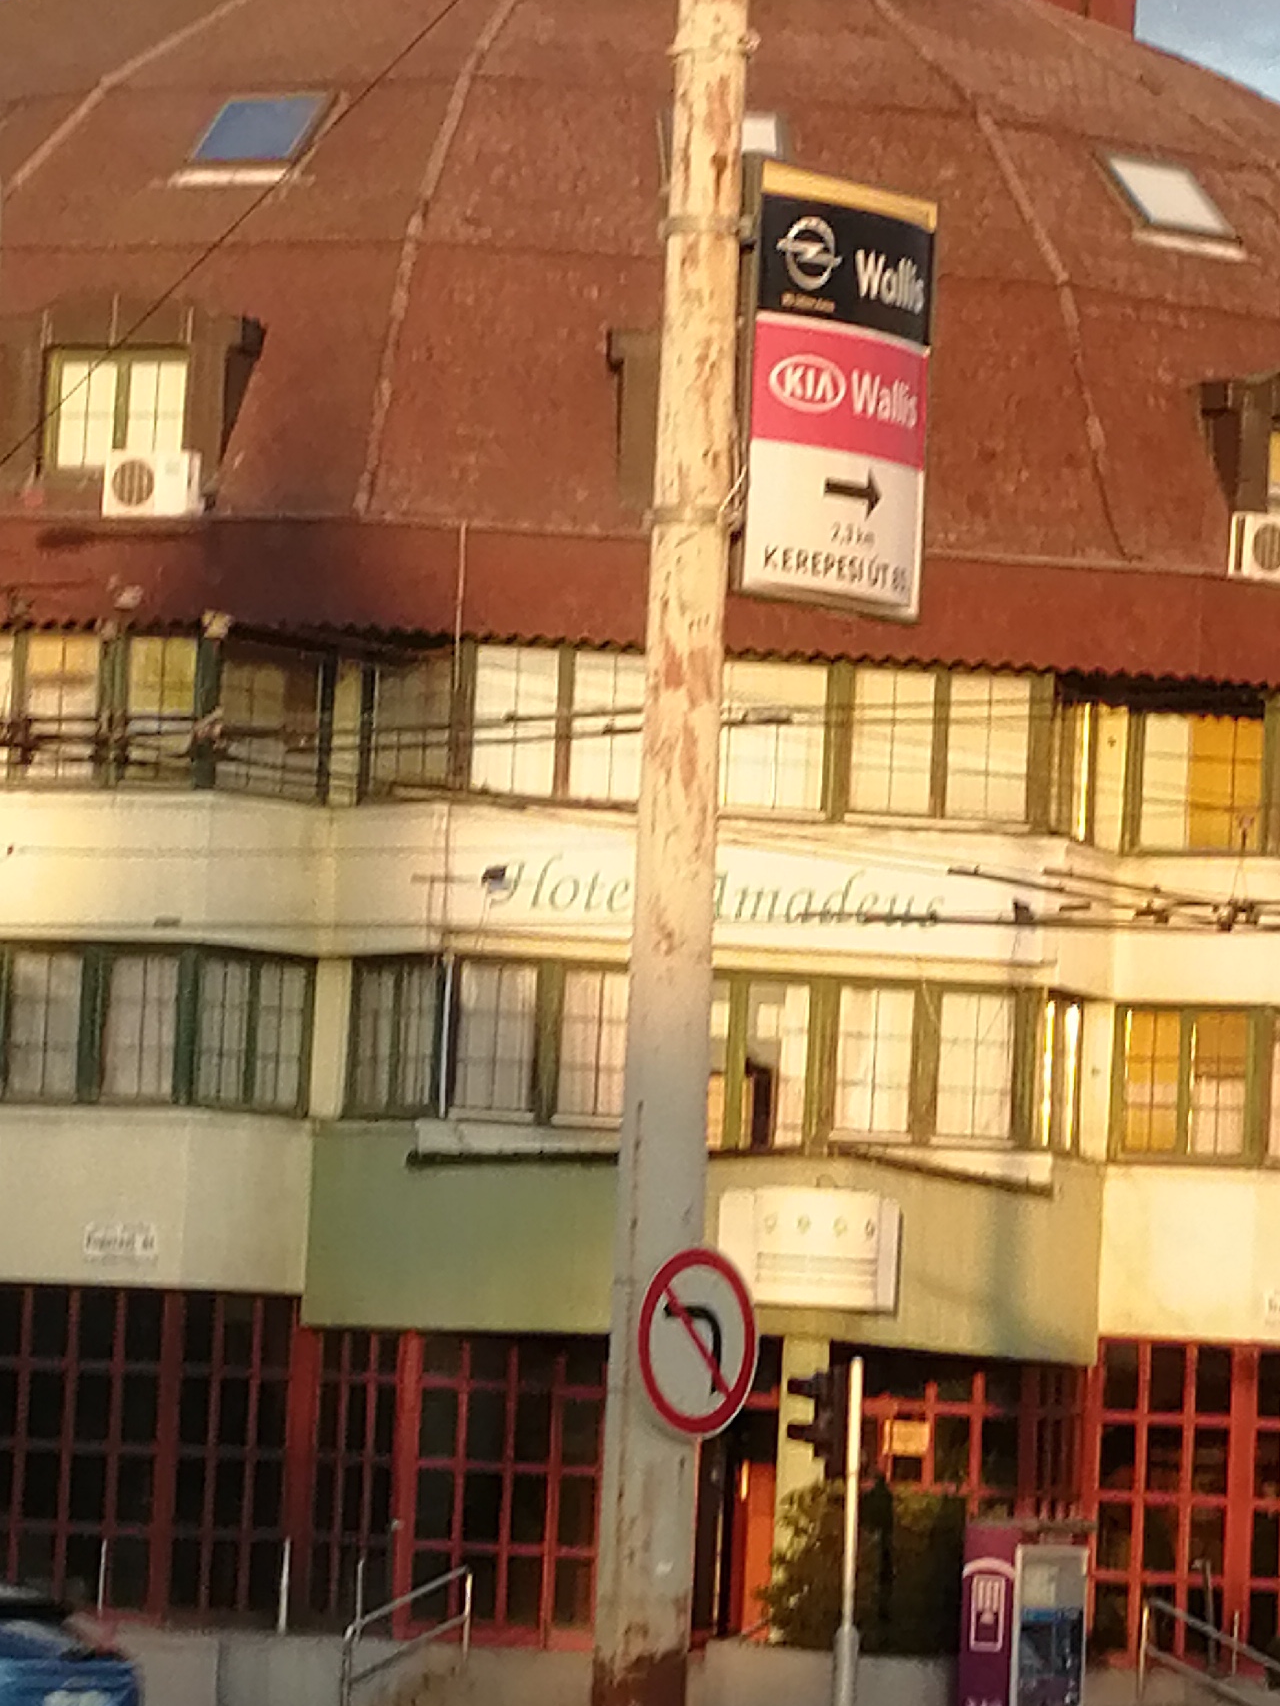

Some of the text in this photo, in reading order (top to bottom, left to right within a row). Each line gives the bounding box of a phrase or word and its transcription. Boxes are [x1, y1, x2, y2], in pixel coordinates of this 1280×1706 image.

[855, 249, 925, 315] Wallis
[782, 364, 918, 430] KIA Wallis
[762, 543, 864, 584] KEREPESI
[867, 553, 890, 590] ÚT
[489, 853, 631, 913] Hote
